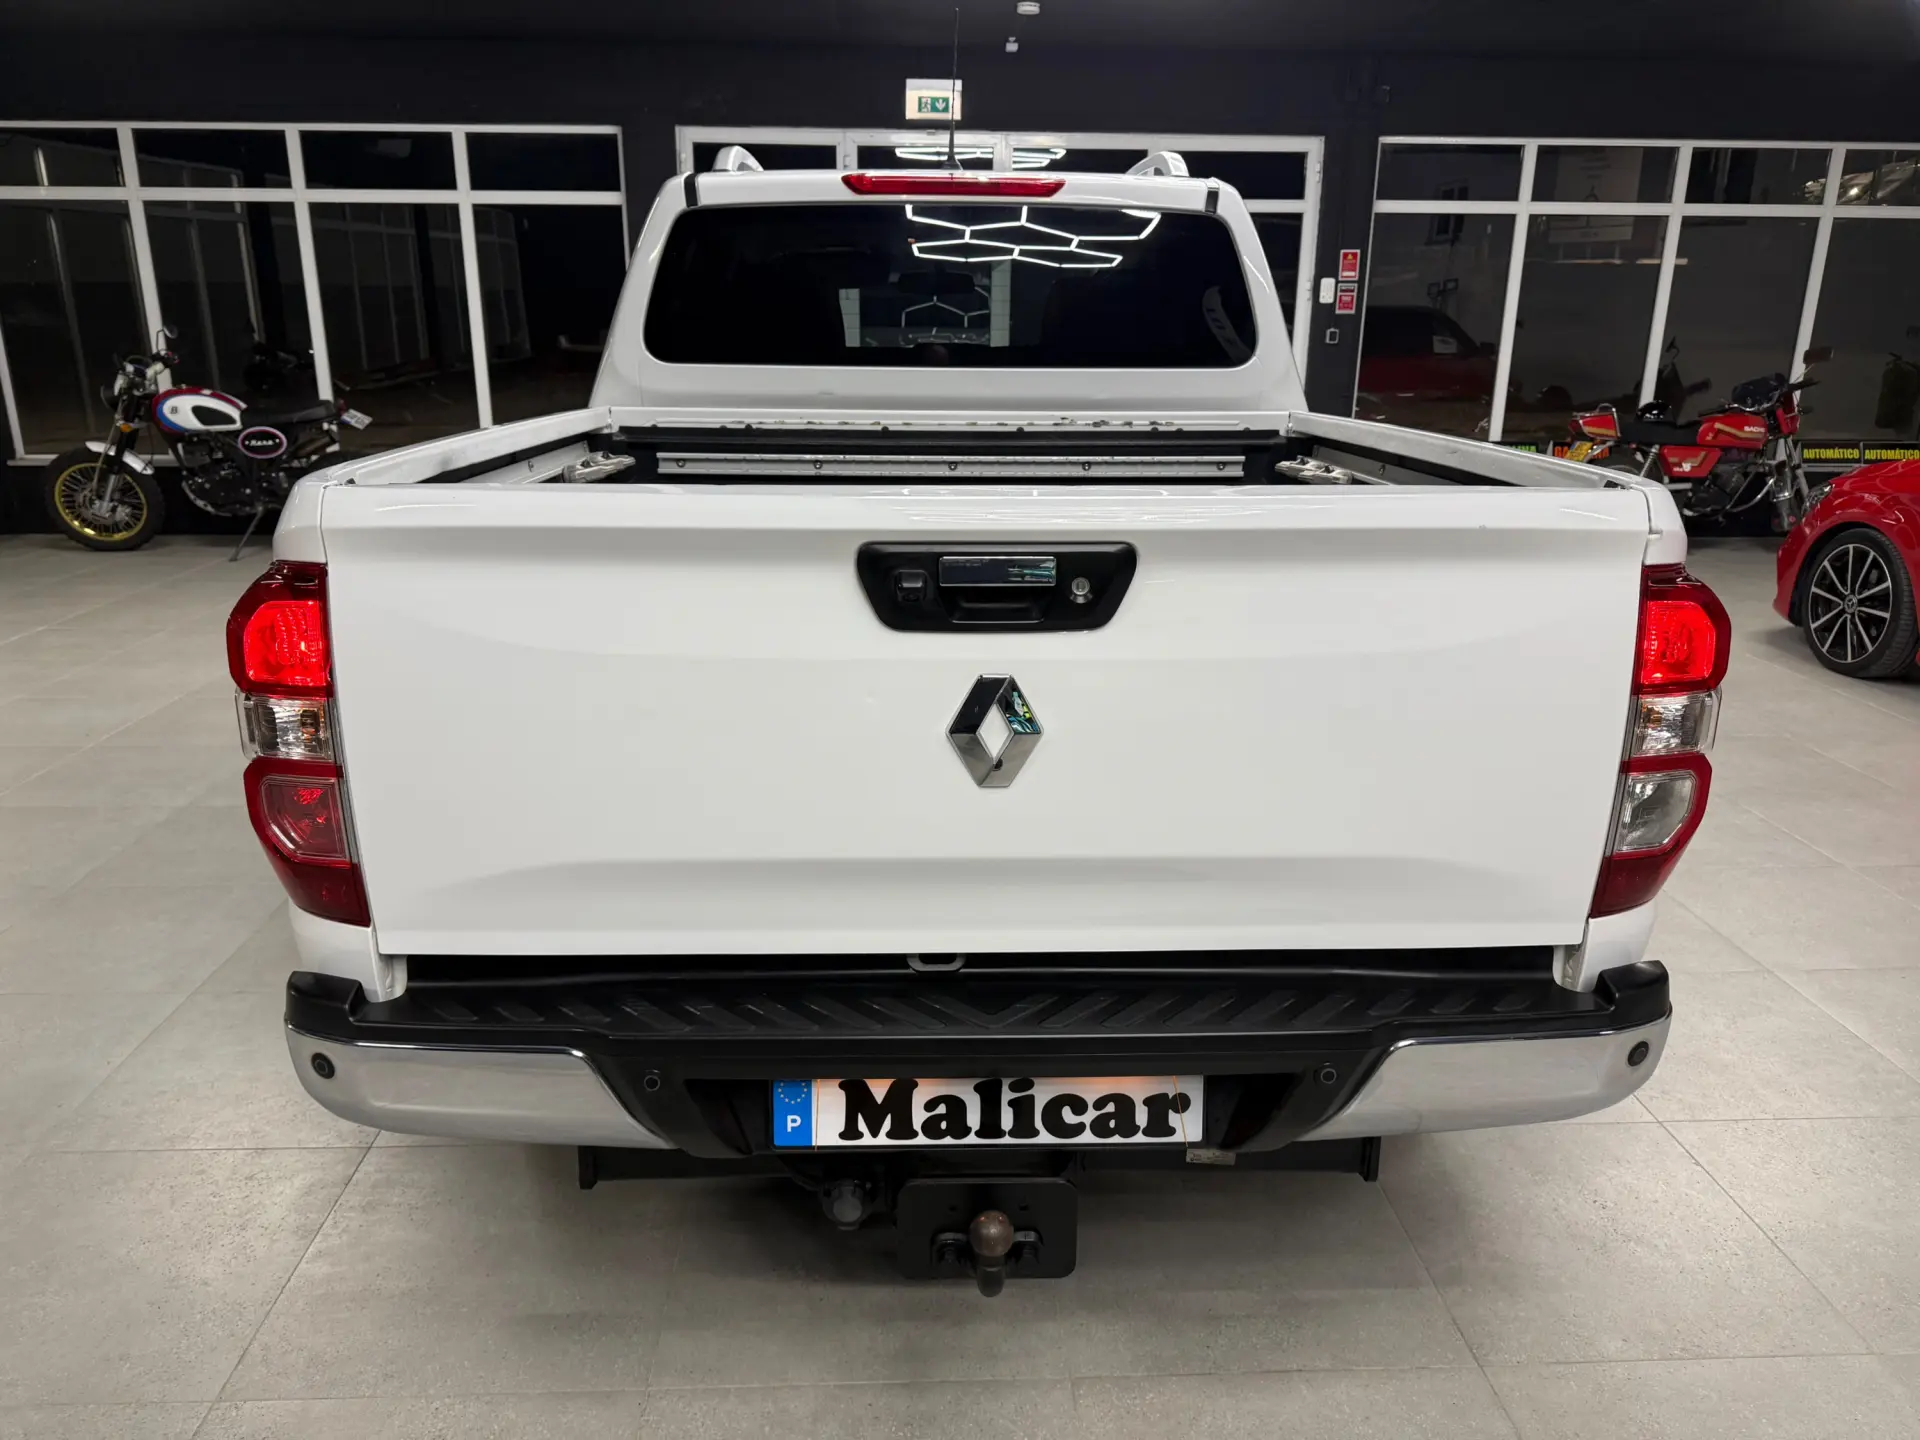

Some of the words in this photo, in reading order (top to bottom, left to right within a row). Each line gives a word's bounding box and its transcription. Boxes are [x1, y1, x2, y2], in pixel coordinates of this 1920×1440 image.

[1803, 446, 1860, 460] AUTOMÁTICO
[838, 1078, 1192, 1141] Malicar
[786, 1114, 802, 1133] P
